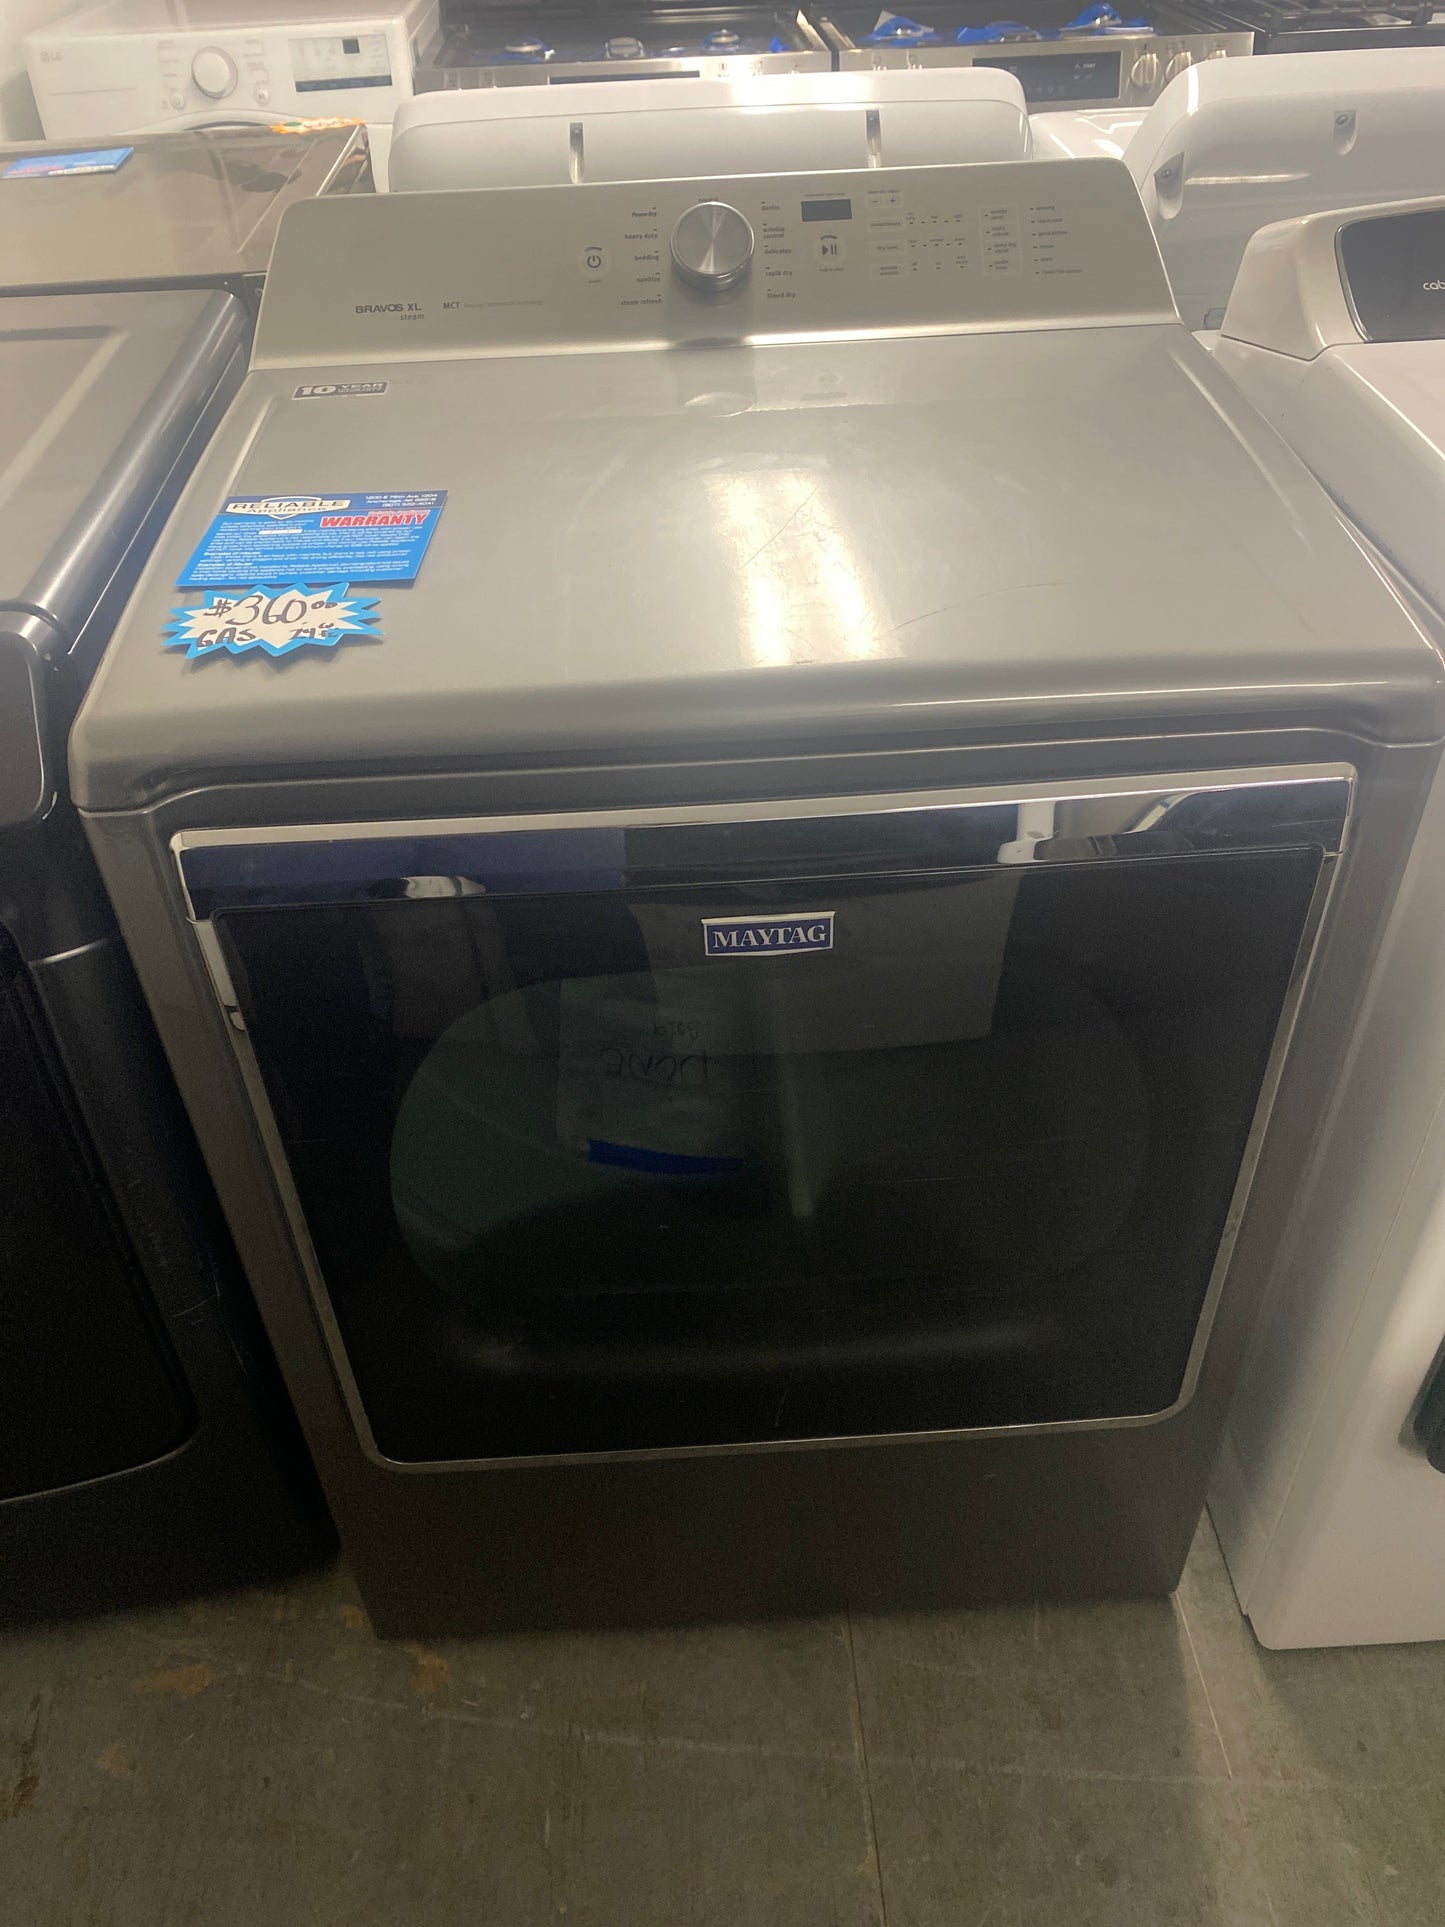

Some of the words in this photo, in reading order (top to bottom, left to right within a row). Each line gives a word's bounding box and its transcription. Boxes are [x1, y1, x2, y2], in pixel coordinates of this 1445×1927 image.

[355, 303, 404, 314] BRAVOS
[407, 303, 422, 311] XL
[443, 301, 460, 310] MCT
[400, 313, 424, 321] steam
[301, 385, 337, 396] 10
[232, 500, 345, 510] RELIABLE
[247, 506, 327, 514] Appliance
[320, 513, 428, 528] WARRANTY
[196, 627, 257, 648] GAS
[712, 924, 827, 949] MAYTAG
